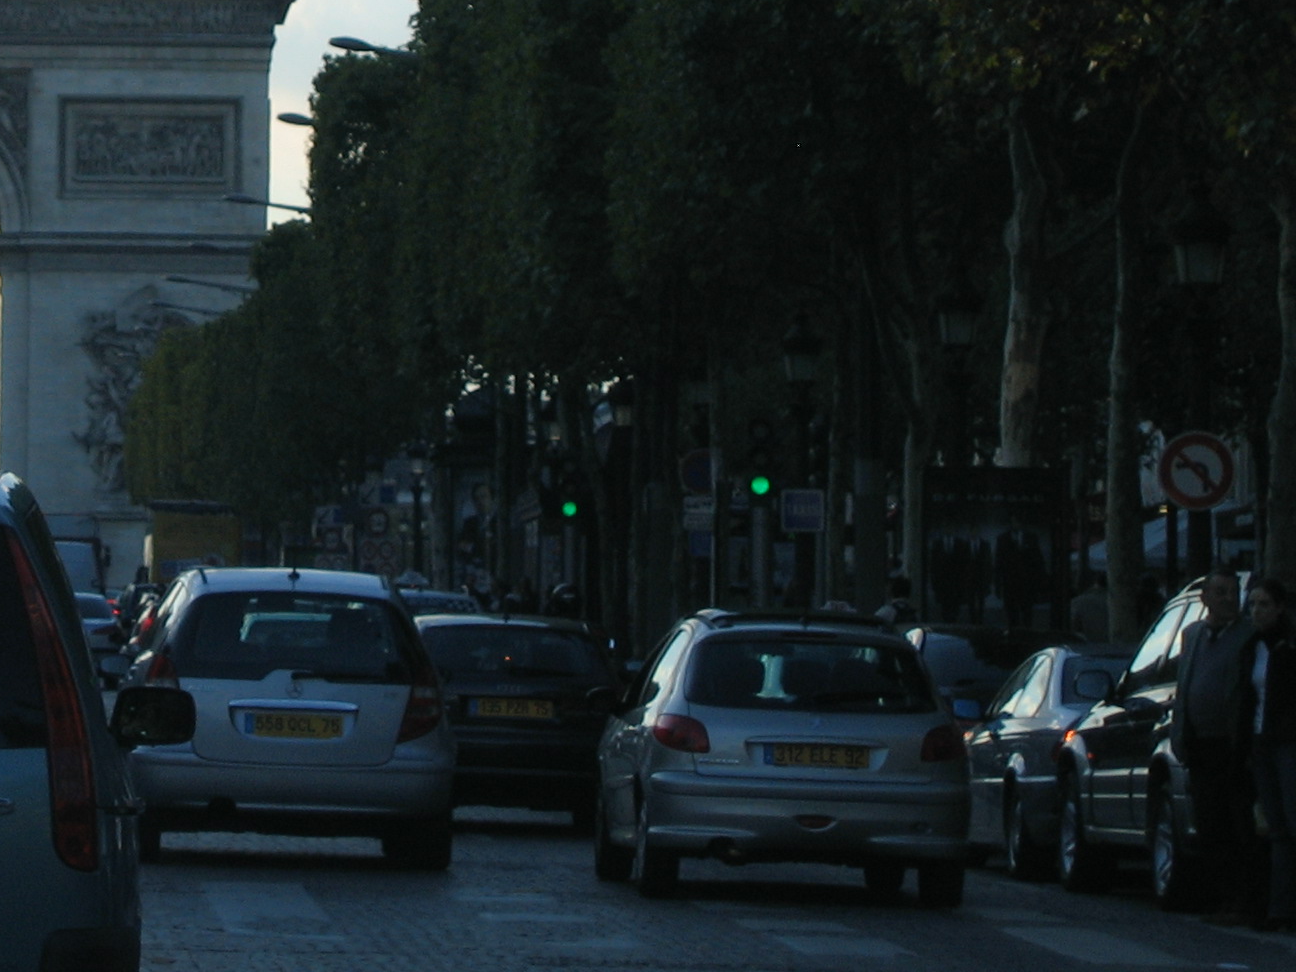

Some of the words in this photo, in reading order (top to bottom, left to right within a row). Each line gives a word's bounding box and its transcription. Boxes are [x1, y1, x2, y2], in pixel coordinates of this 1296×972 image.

[255, 715, 284, 731] 558
[321, 717, 340, 734] 75
[776, 745, 803, 762] 312
[809, 746, 836, 764] ELE
[845, 748, 865, 765] 92
